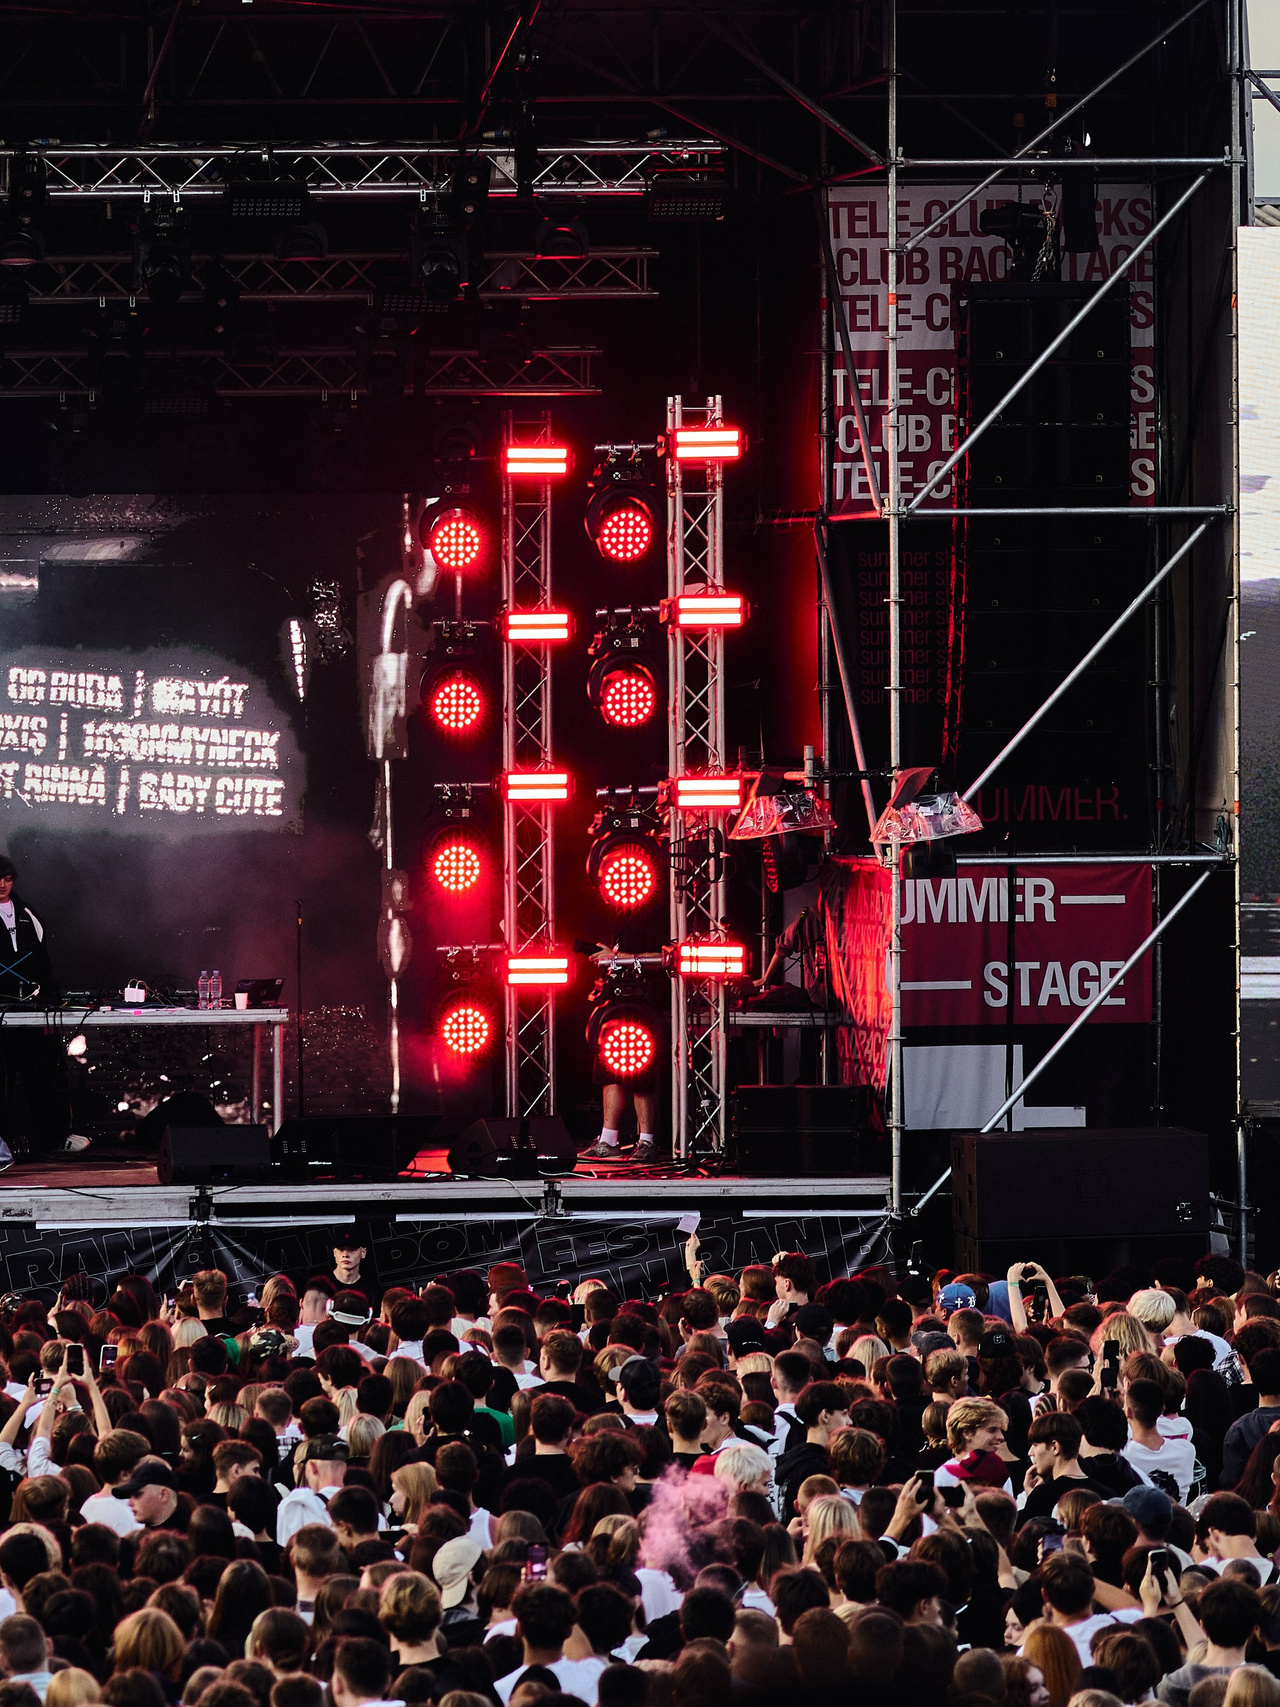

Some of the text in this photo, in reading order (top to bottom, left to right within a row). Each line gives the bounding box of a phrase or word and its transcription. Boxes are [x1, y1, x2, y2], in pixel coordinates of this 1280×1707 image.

[828, 199, 1012, 239] TELE-CLU
[976, 785, 1129, 823] UMMER.
[983, 960, 1126, 1008] STAGE
[4, 1227, 161, 1292] RAN
[372, 1219, 521, 1275] DOM
[535, 1217, 682, 1273] FEST
